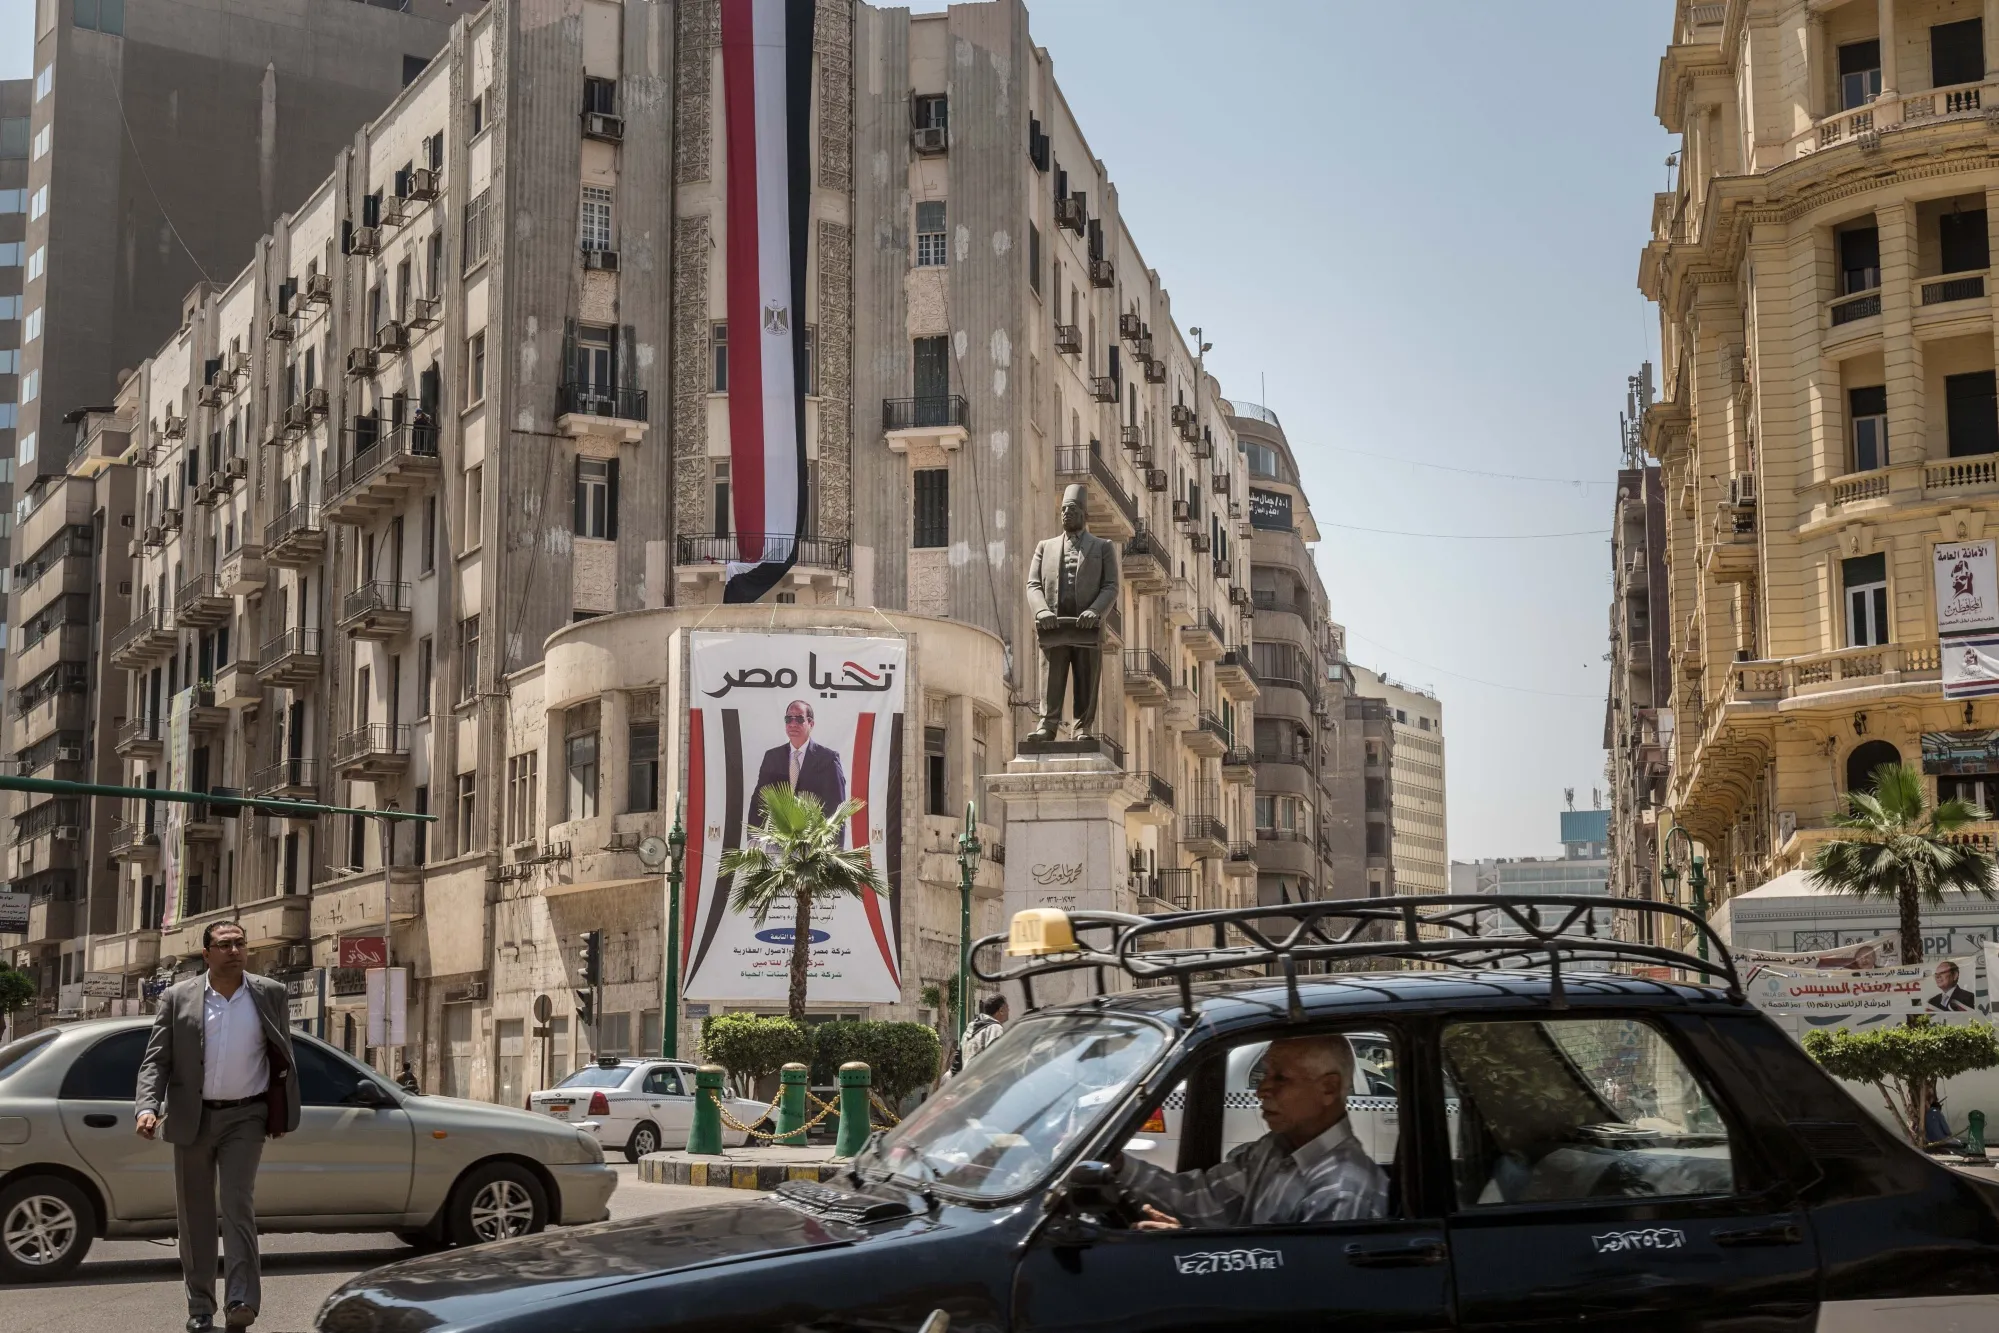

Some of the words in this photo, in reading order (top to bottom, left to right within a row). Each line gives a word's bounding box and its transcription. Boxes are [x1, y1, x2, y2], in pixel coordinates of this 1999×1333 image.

[1937, 551, 1960, 561] العامة
[1962, 546, 1988, 558] الأمانة
[1944, 596, 1983, 617] المحافظين
[809, 651, 896, 699] تحيا
[701, 667, 798, 699] مصر
[1038, 863, 1074, 885] طلعت
[1059, 862, 1083, 886] محمد
[770, 933, 789, 941] التابعة
[733, 947, 762, 956] العقارية
[813, 947, 829, 956] مصر
[831, 947, 851, 956] شركة
[740, 970, 764, 979] الحياة
[767, 970, 788, 979] مينات
[821, 971, 842, 979] شركة
[1896, 967, 1920, 975] الحملة
[298, 978, 314, 993] TOURS
[1853, 981, 1892, 997] الفتاح
[1893, 981, 1921, 995] عبد
[1768, 1000, 1790, 1008] النجمة
[1790, 1001, 1801, 1009] رمز
[1816, 1001, 1833, 1009] رقم
[1864, 999, 1891, 1008] المرشح
